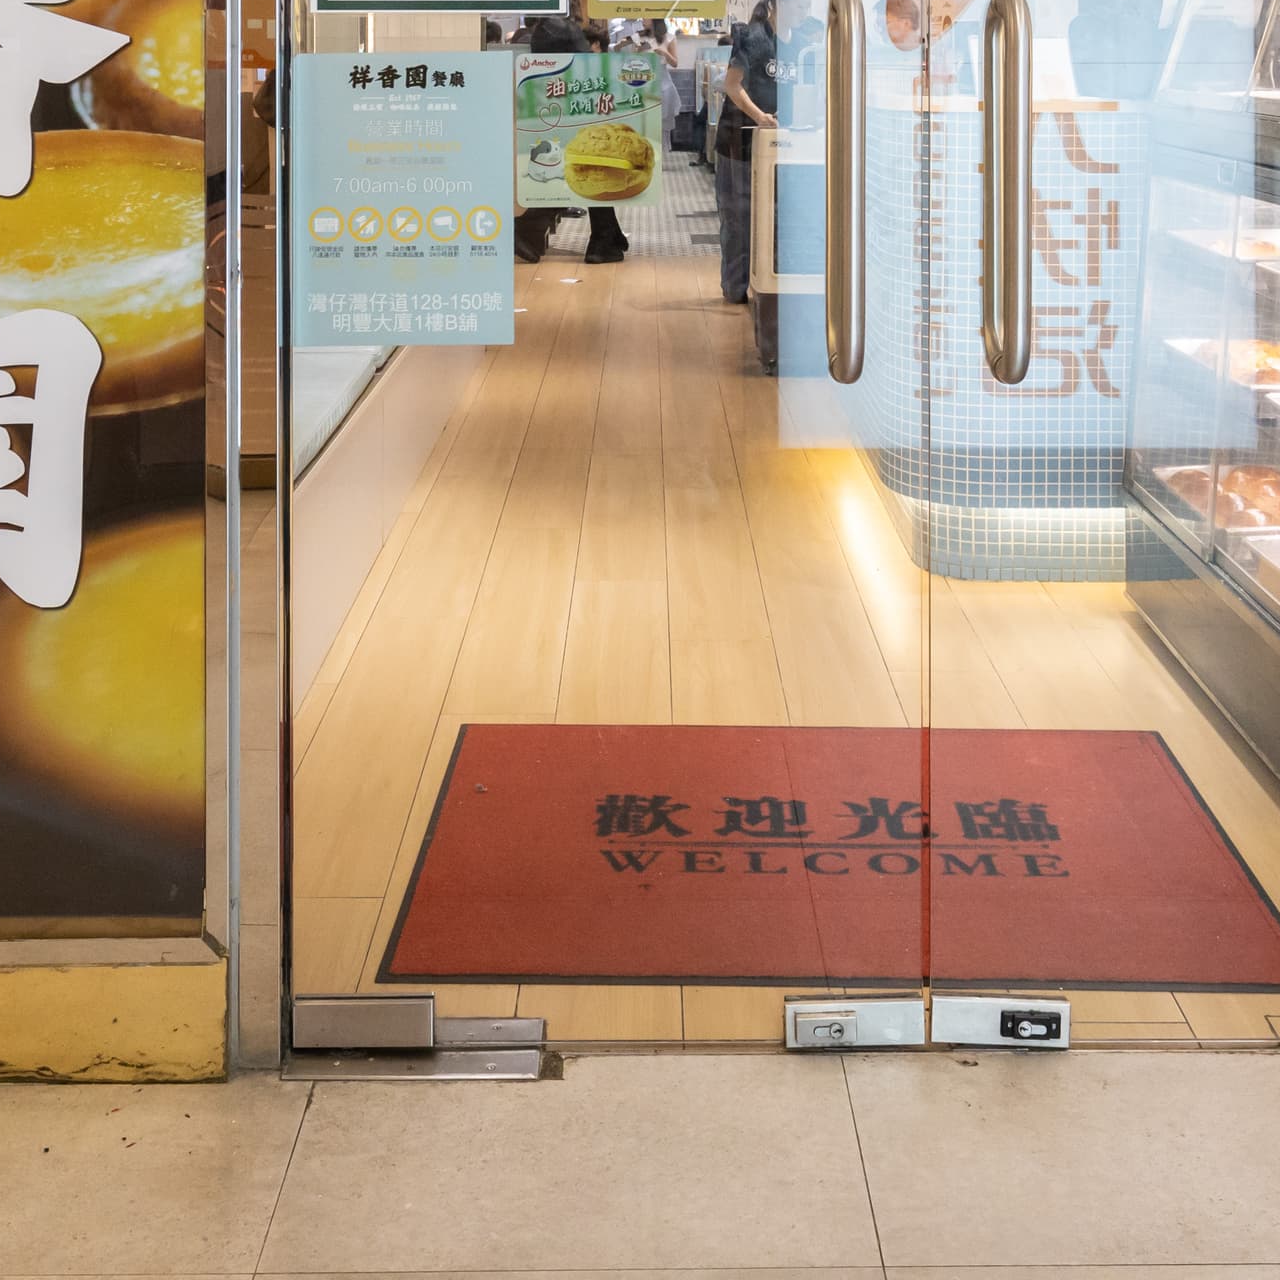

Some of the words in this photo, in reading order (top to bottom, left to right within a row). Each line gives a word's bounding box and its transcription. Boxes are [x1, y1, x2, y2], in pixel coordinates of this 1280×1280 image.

[349, 64, 466, 90] 祥香園餐廳
[531, 60, 557, 68] Anchor
[307, 292, 503, 313] 灣仔灣仔道128-150號
[593, 794, 1061, 842] 歡迎光臨
[599, 850, 1071, 878] WELCOME
